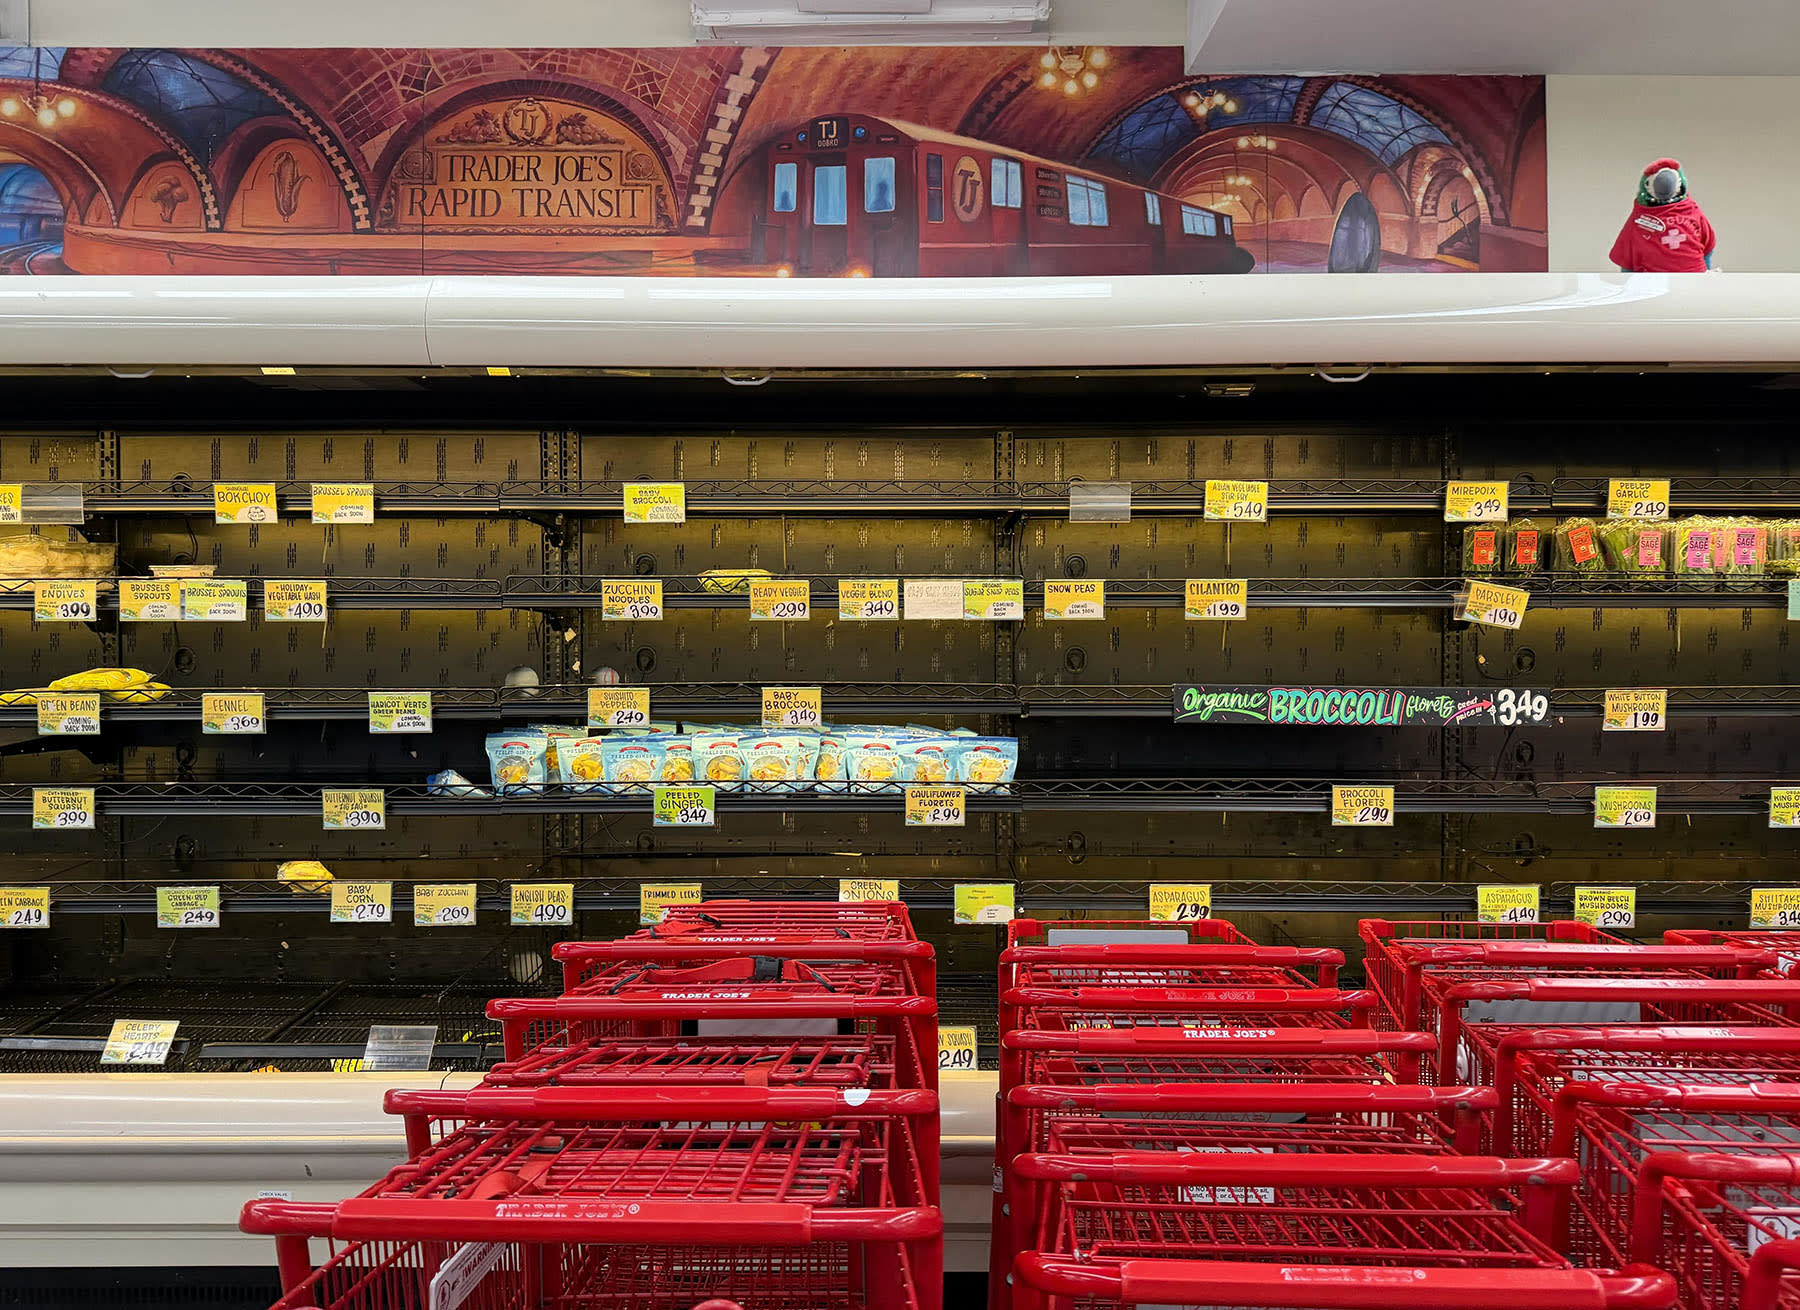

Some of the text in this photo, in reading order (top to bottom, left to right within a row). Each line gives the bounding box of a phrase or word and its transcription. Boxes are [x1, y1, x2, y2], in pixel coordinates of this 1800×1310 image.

[513, 107, 538, 137] TJ
[818, 120, 837, 139] TJ
[441, 153, 613, 186] TRADER JOE'S
[957, 169, 981, 214] TJ
[408, 187, 645, 219] RAPID TRANSIT
[313, 486, 374, 496] BRUSSEL SPROUTS
[1451, 486, 1497, 496] MIREPOIX
[1616, 490, 1649, 499] GARLIC
[632, 496, 672, 505] BROCCOLI
[1640, 540, 1659, 549] SAGE
[1689, 540, 1708, 550] SAGE
[1736, 537, 1755, 547] SAGE
[130, 583, 170, 592] BRUSSELS
[187, 587, 247, 598] BRUSSEL SPROUTS
[280, 583, 308, 592] HOLIDAY
[604, 584, 656, 595] ZUCCHINI
[752, 586, 808, 598] READY VEGGIES
[964, 588, 985, 597] SUGAR
[986, 587, 1003, 596] SNAP
[1004, 588, 1020, 596] PEAS
[1047, 583, 1096, 594] SNOW PEAS
[1189, 582, 1240, 595] CILANTRO
[41, 589, 85, 599] ENDIVES
[133, 592, 172, 601] SPROUTS
[267, 591, 321, 601] VEGETABLE HASH
[840, 589, 867, 599] VEGGIE
[868, 589, 894, 599] BLEND
[1475, 587, 1519, 605] PARSLEY
[608, 595, 651, 604] NOODLES
[603, 691, 634, 700] SHISHITO
[773, 691, 800, 700] BABY
[1607, 693, 1662, 702] WHITE BUTTON
[69, 699, 97, 711] BEANS
[212, 699, 249, 712] FENNEL
[370, 700, 427, 709] HARICOT VERTS
[600, 700, 638, 710] PEPPERS
[764, 700, 817, 710] BROCCOLI
[1183, 687, 1456, 726] Organic BROCCOLI florets
[1611, 702, 1660, 713] MUSHROOMS
[67, 717, 91, 725] COMING
[910, 790, 961, 799] CAULIFLOWER
[1340, 789, 1384, 799] BROCCOLI
[42, 796, 88, 804] BUTTERNUT
[660, 799, 705, 810] GINGER
[919, 799, 954, 807] FLORETS
[1343, 798, 1386, 808] FLORETS
[48, 803, 82, 811] SQUASH
[1600, 801, 1653, 811] MUSHROOMS
[347, 885, 372, 895] BABY
[850, 880, 882, 890] GREEN
[415, 888, 469, 897] BABY ZUCCHINI
[514, 889, 567, 903] ENGLISH PEAS
[643, 889, 700, 899] TRIMMED LEEKS
[842, 889, 895, 901] ONIONS
[1152, 890, 1207, 903] ASPARAGUS
[14, 897, 45, 907] CABBAGE
[346, 894, 375, 904] CORN
[1485, 892, 1533, 904] ASPARAGUS
[1578, 894, 1606, 902] BROWN
[1578, 902, 1629, 910] MUSHROOMS
[125, 1023, 162, 1032] CELERY
[123, 1031, 160, 1041] HEARTS
[1183, 1029, 1231, 1039] TRADER
